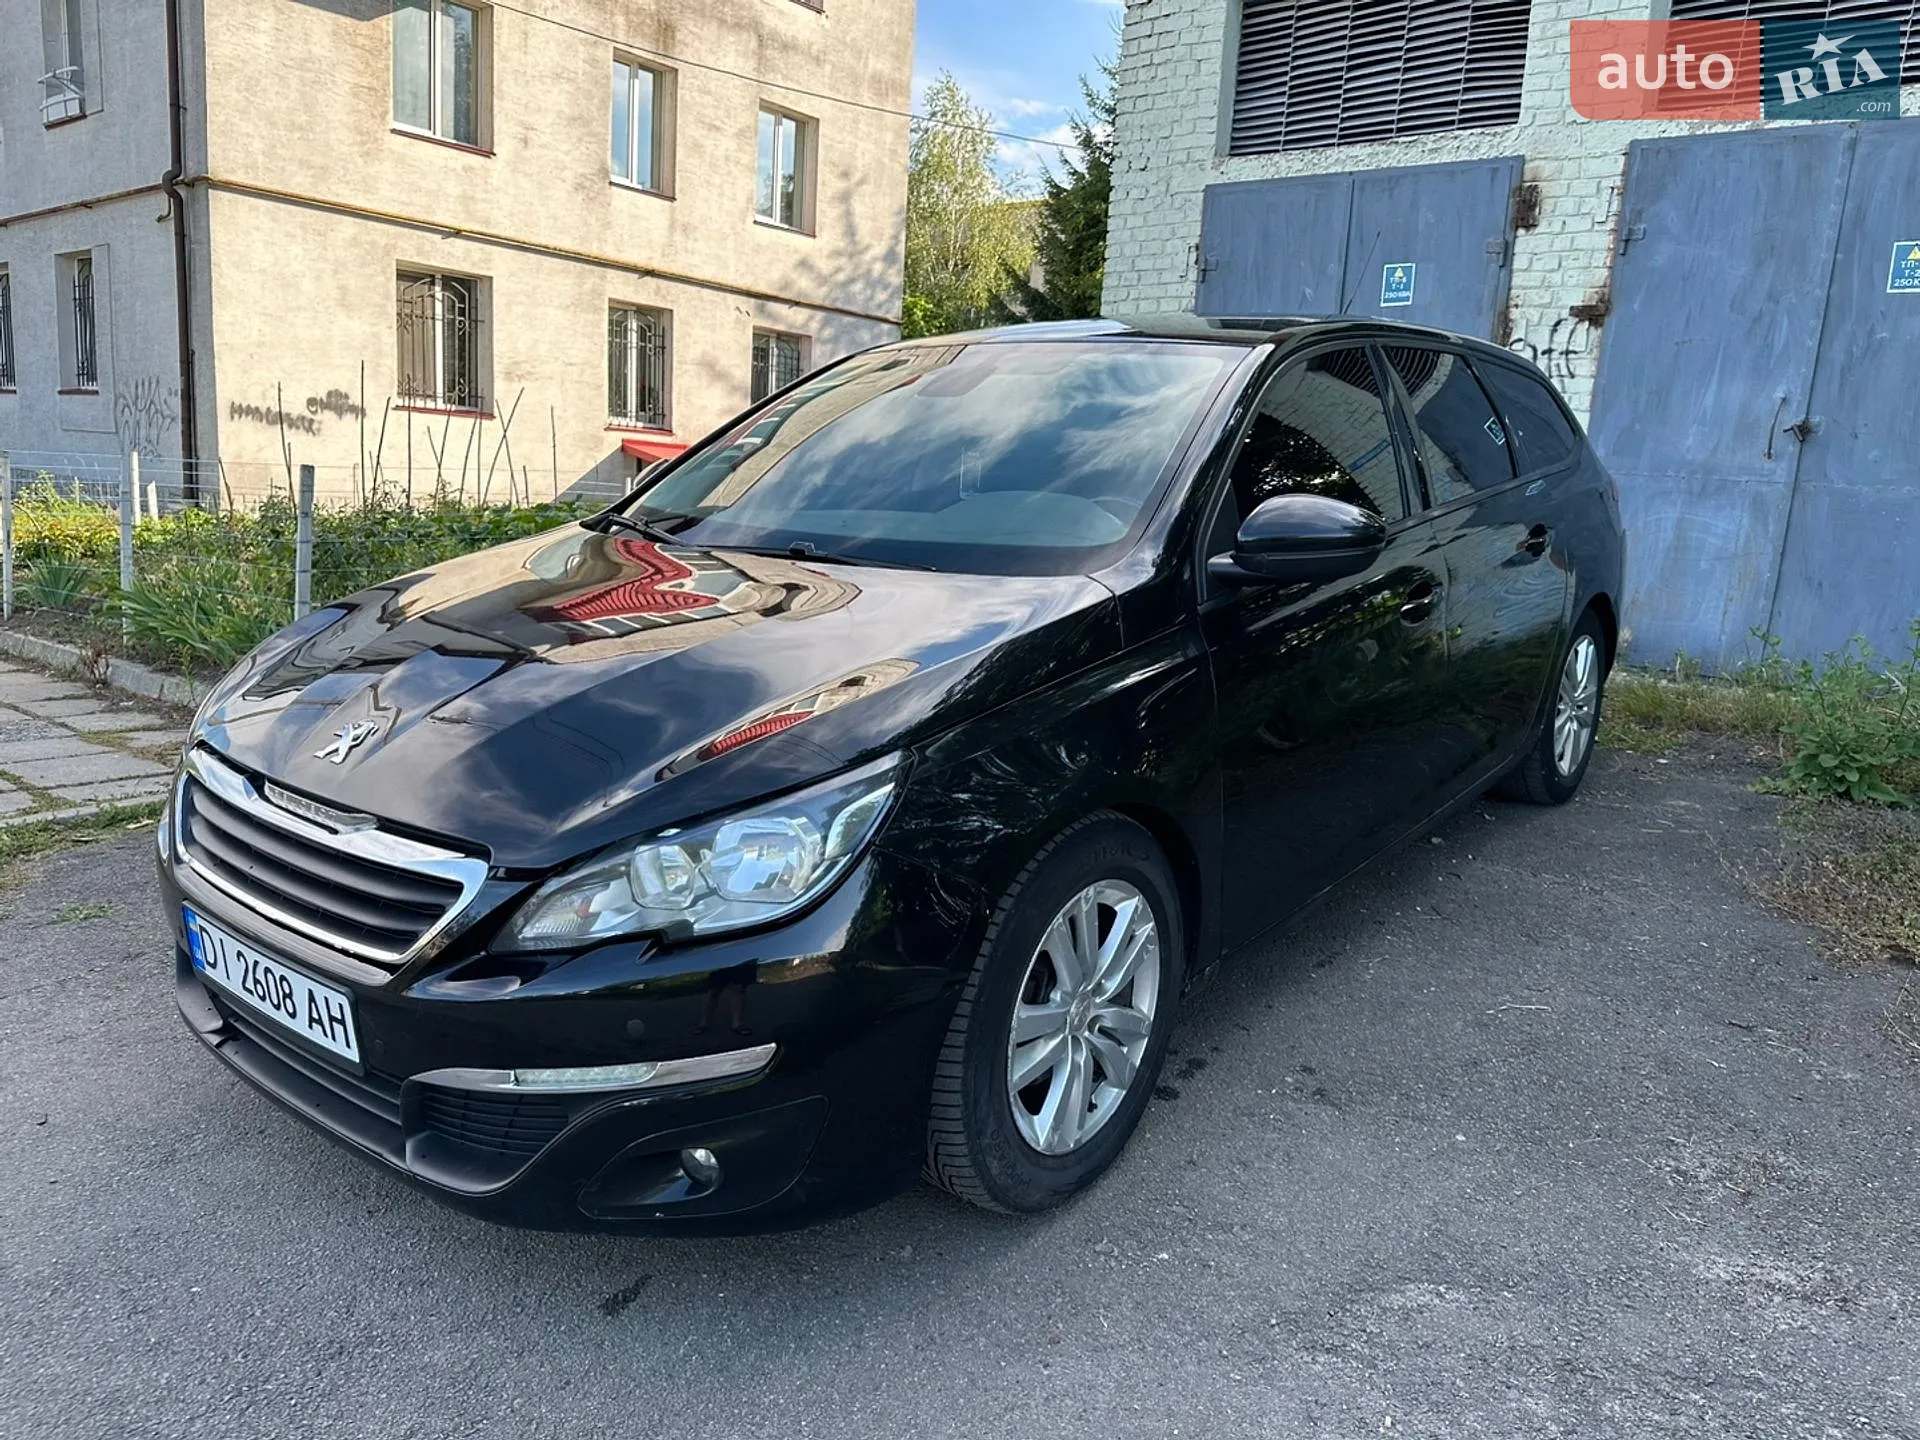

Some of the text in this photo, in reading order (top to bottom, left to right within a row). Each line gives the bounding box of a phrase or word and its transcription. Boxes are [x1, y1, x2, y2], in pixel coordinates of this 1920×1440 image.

[198, 924, 351, 1049] DI 2608 AH
